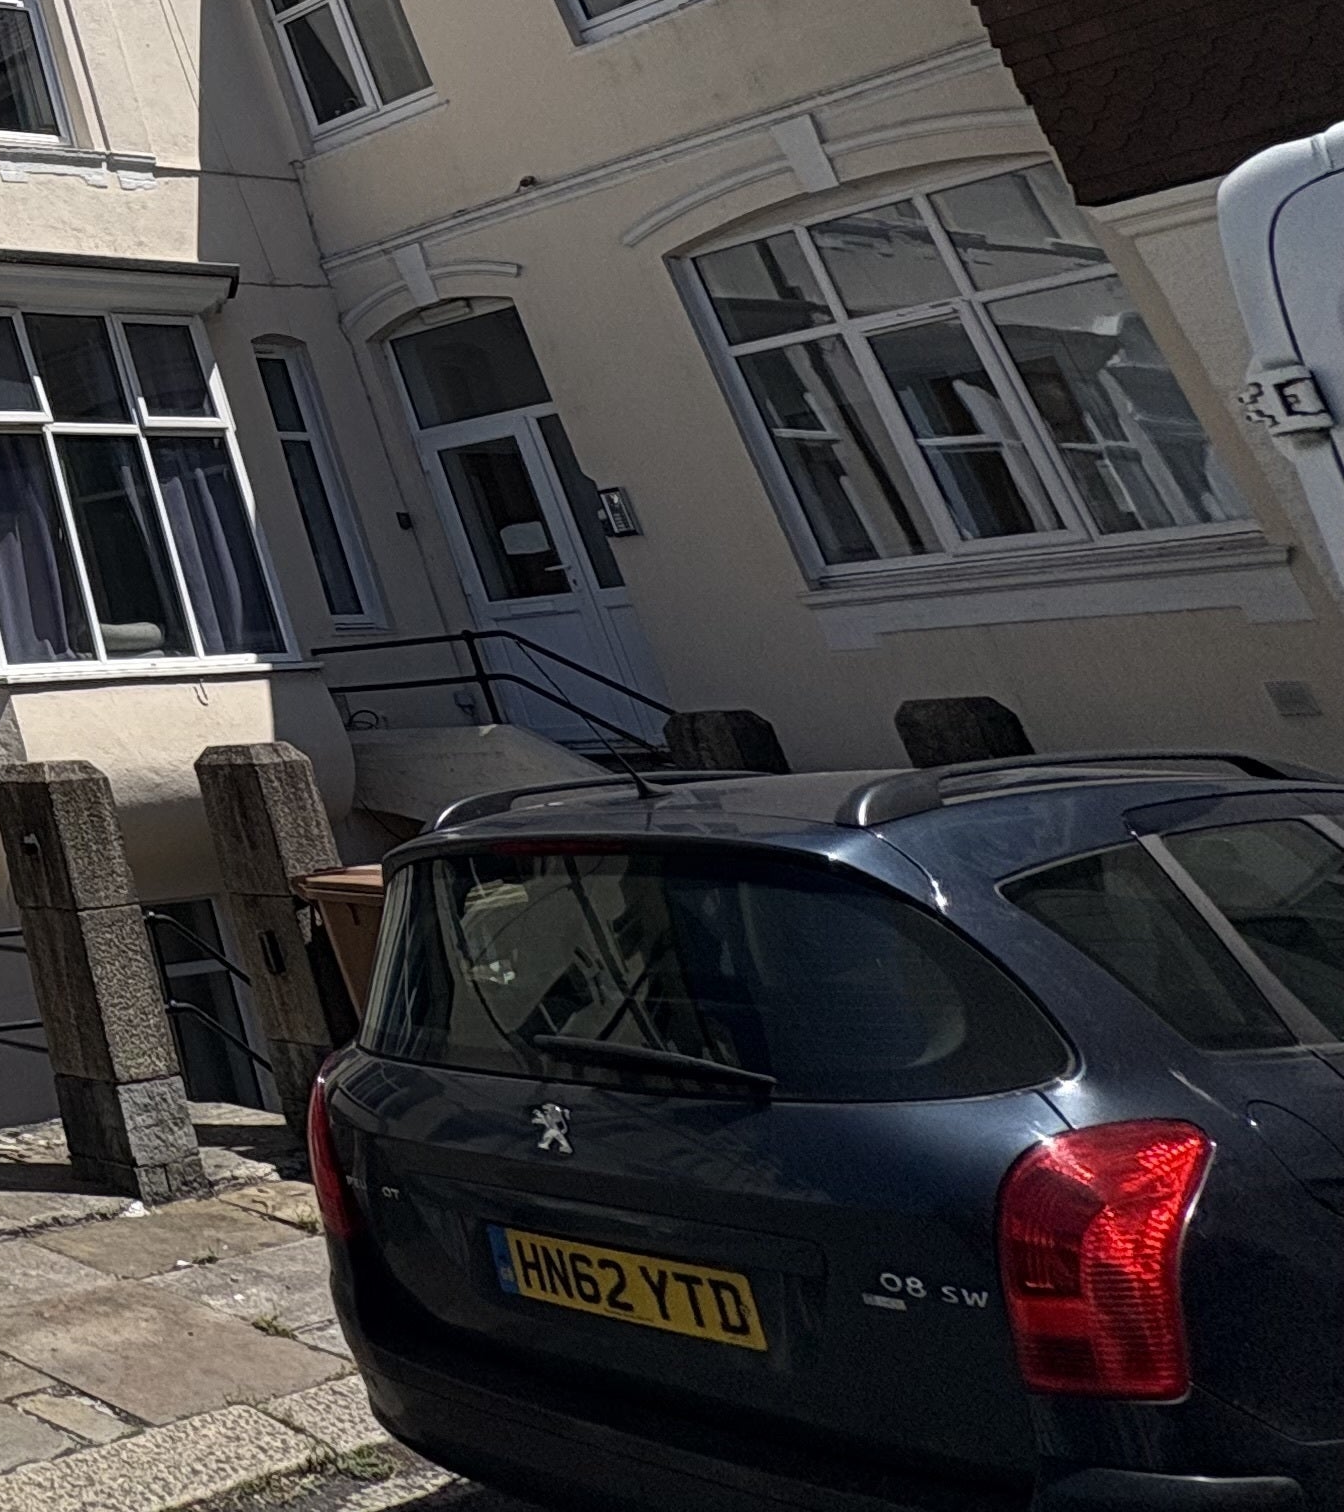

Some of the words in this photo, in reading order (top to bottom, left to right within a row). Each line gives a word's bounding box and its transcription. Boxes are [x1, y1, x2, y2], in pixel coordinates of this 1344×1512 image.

[515, 1239, 635, 1312] HN62
[638, 1265, 752, 1336] YTD
[940, 1285, 989, 1308] SW
